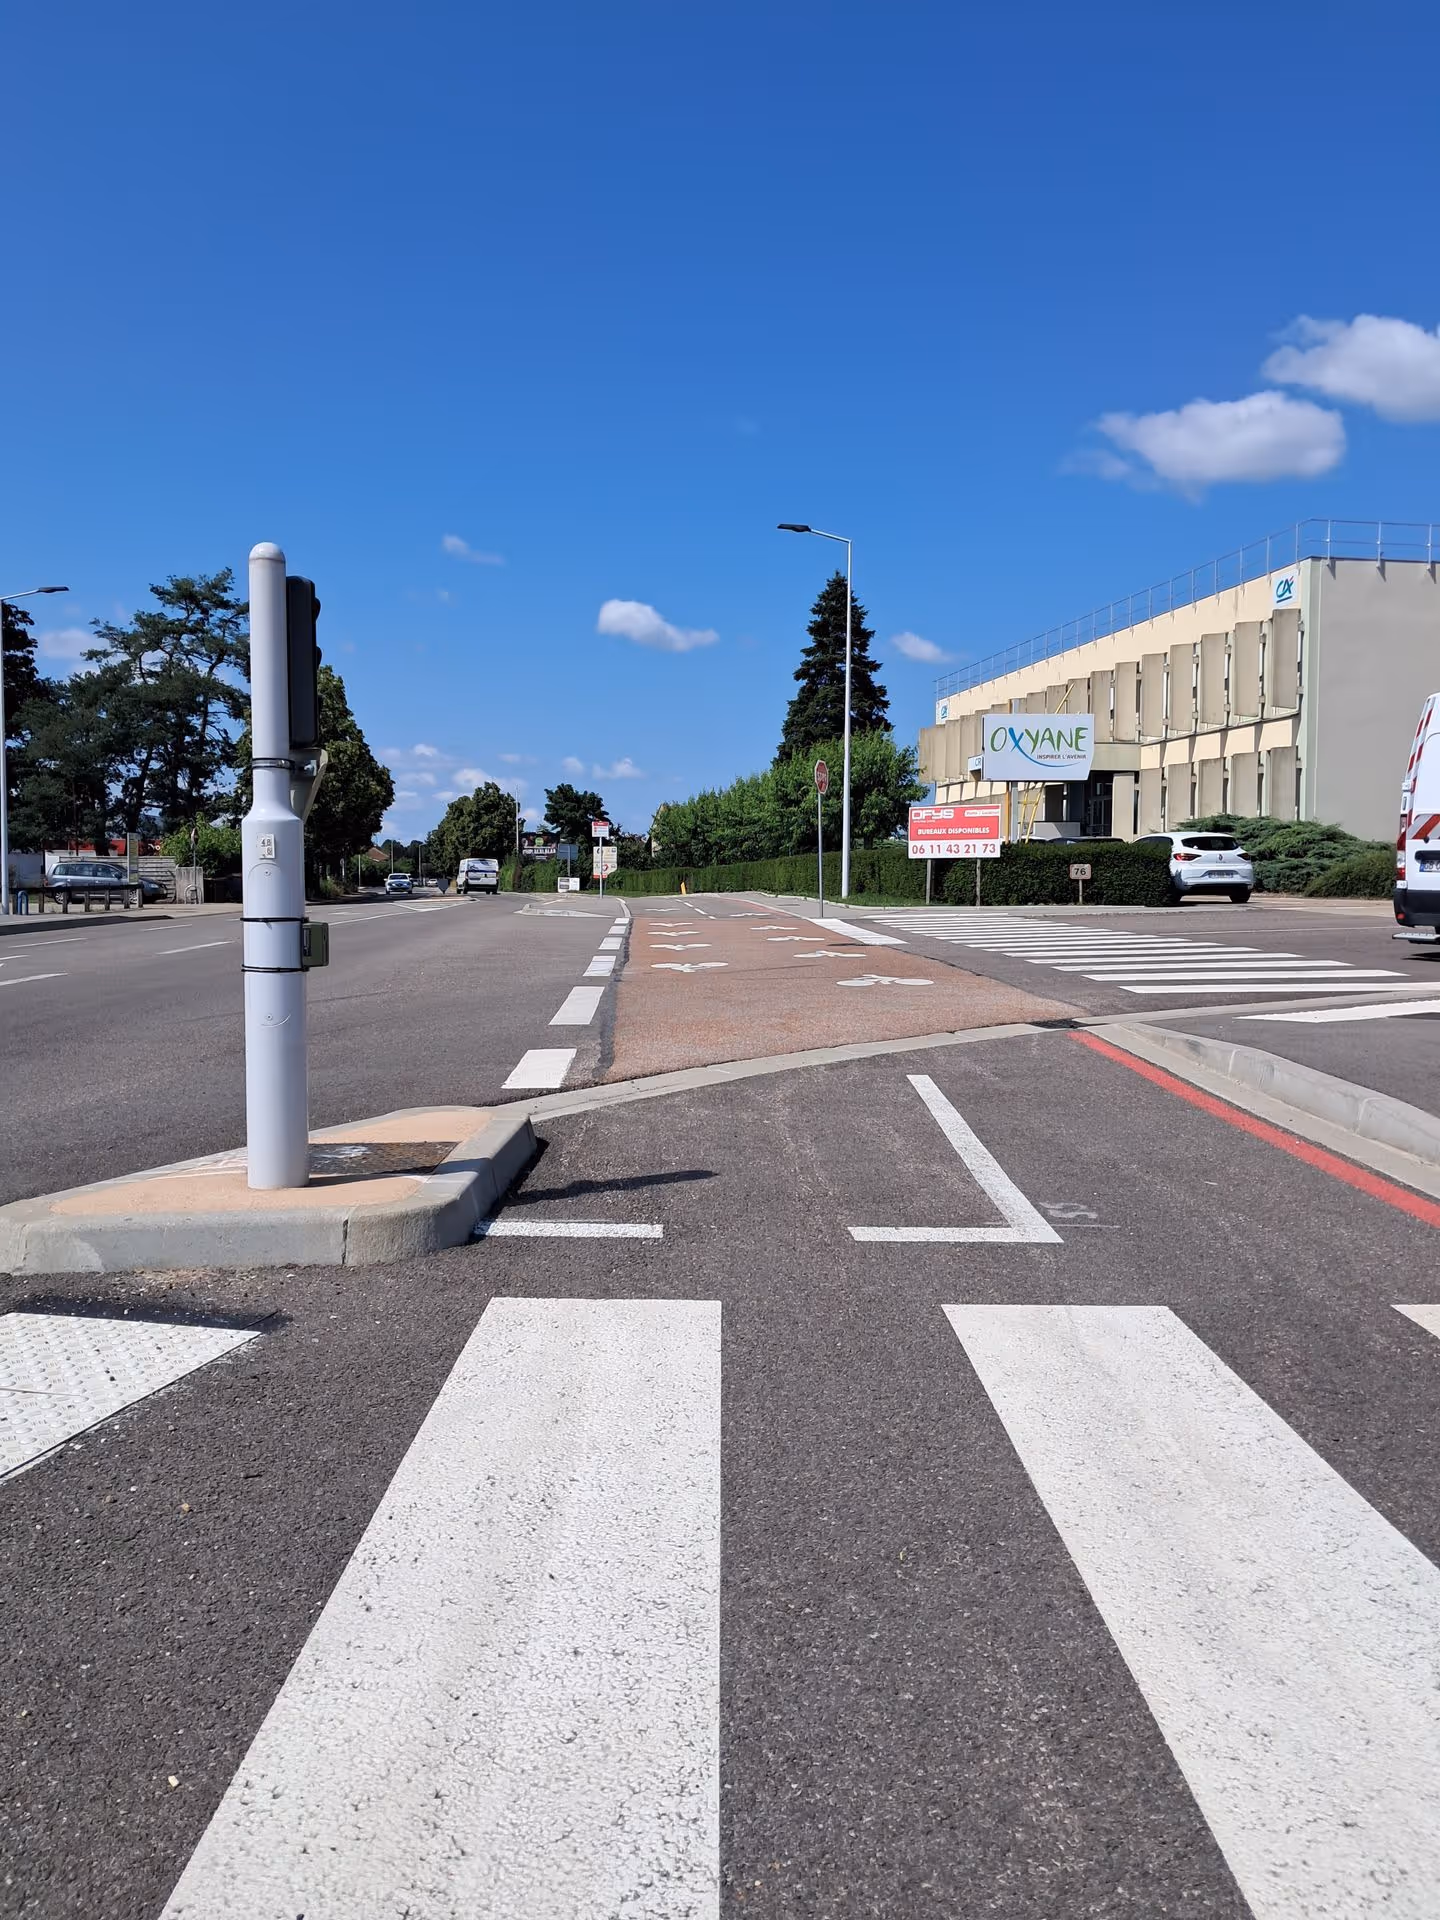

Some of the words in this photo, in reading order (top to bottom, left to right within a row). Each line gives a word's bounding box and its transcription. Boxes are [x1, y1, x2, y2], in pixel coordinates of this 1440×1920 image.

[990, 726, 1088, 756] OXYANE
[911, 845, 925, 854] 06
[929, 844, 941, 854] 11
[945, 844, 960, 853] 43
[963, 843, 977, 854] 21
[982, 843, 996, 854] 73
[1074, 867, 1087, 875] 76
